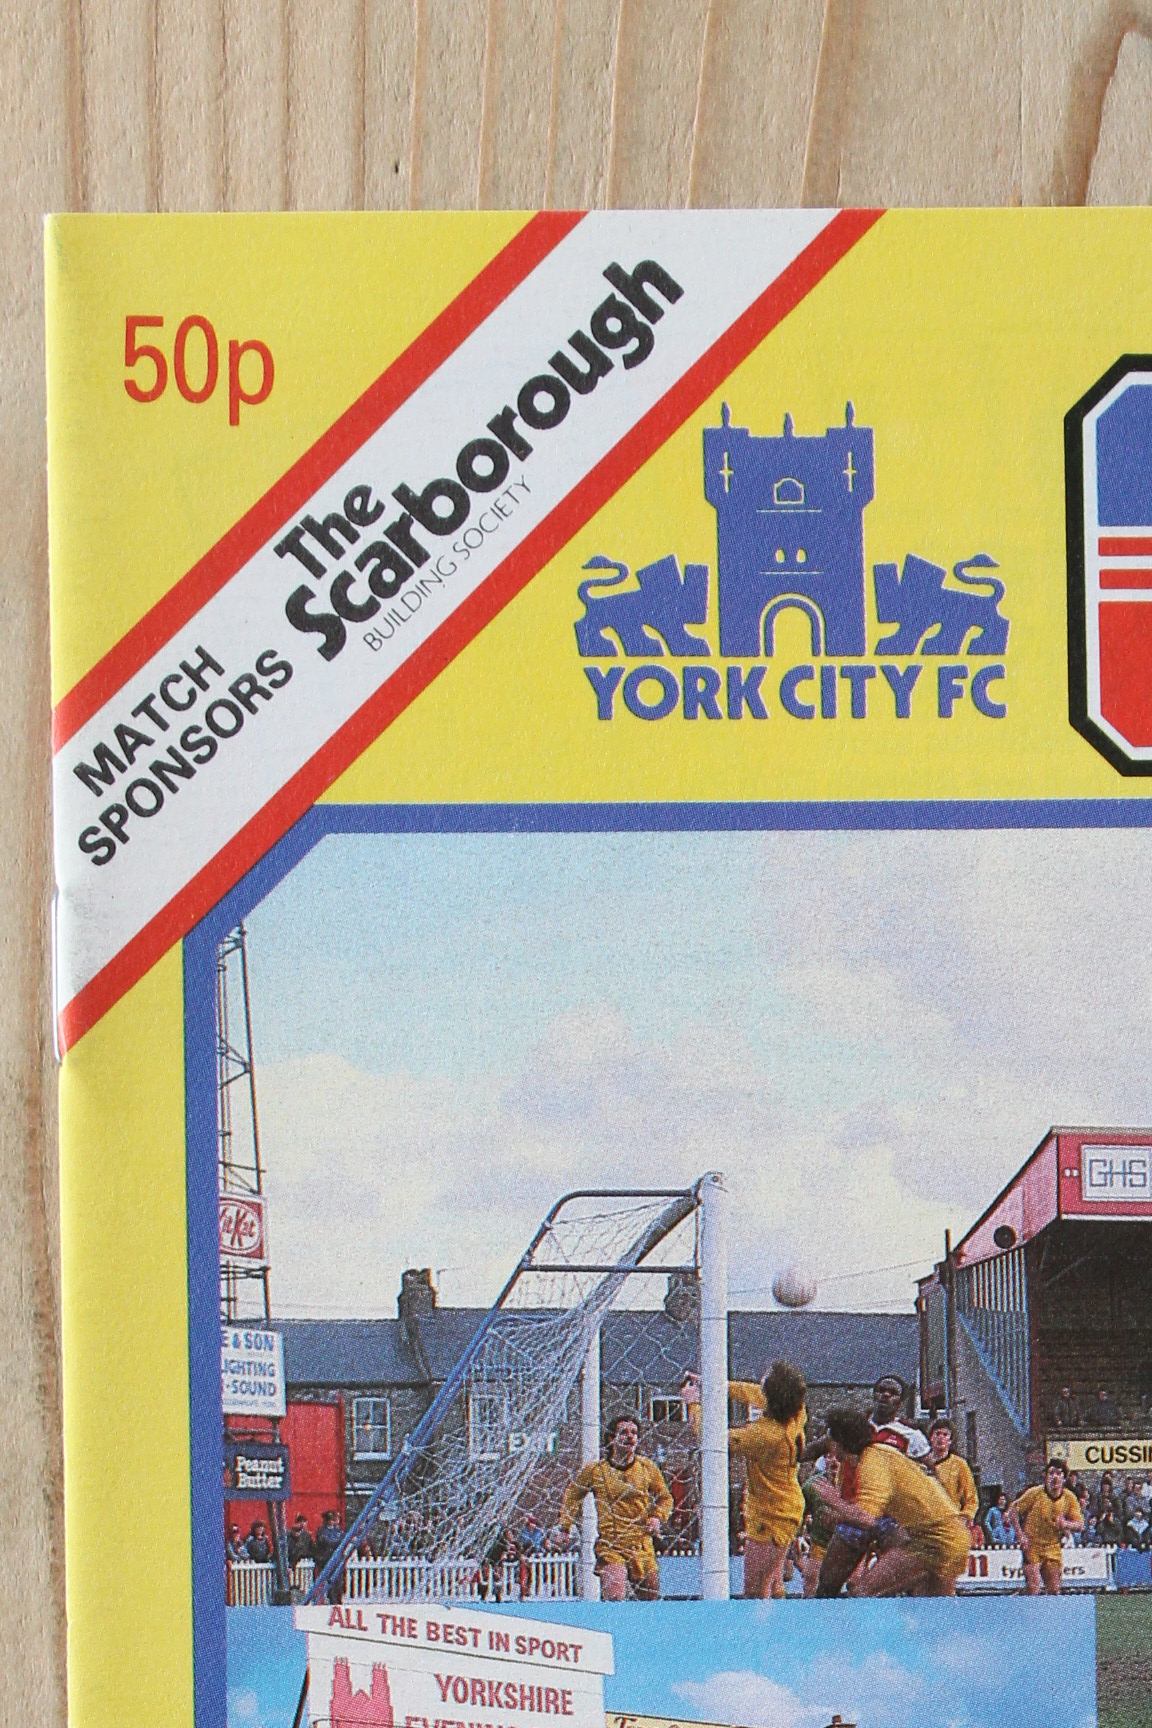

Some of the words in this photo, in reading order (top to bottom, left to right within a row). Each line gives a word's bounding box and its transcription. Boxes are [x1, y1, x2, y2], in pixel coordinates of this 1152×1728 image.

[122, 313, 276, 425] 50p
[284, 258, 685, 663] Scarborough
[273, 483, 385, 572] The
[362, 556, 459, 653] BUILDING
[451, 474, 534, 562] SOCIETY
[73, 644, 225, 797] MATCH
[584, 664, 769, 721] YORK
[779, 664, 923, 720] CITY
[937, 663, 1007, 719] FC
[77, 649, 294, 866] SPONSORS
[243, 1332, 275, 1352] SON
[328, 1606, 368, 1633] ALL
[377, 1613, 418, 1639] THE
[426, 1620, 481, 1649] BEST
[489, 1631, 510, 1652] IN
[515, 1637, 583, 1663] SPORT
[434, 1673, 574, 1716] YORKSHIRE
